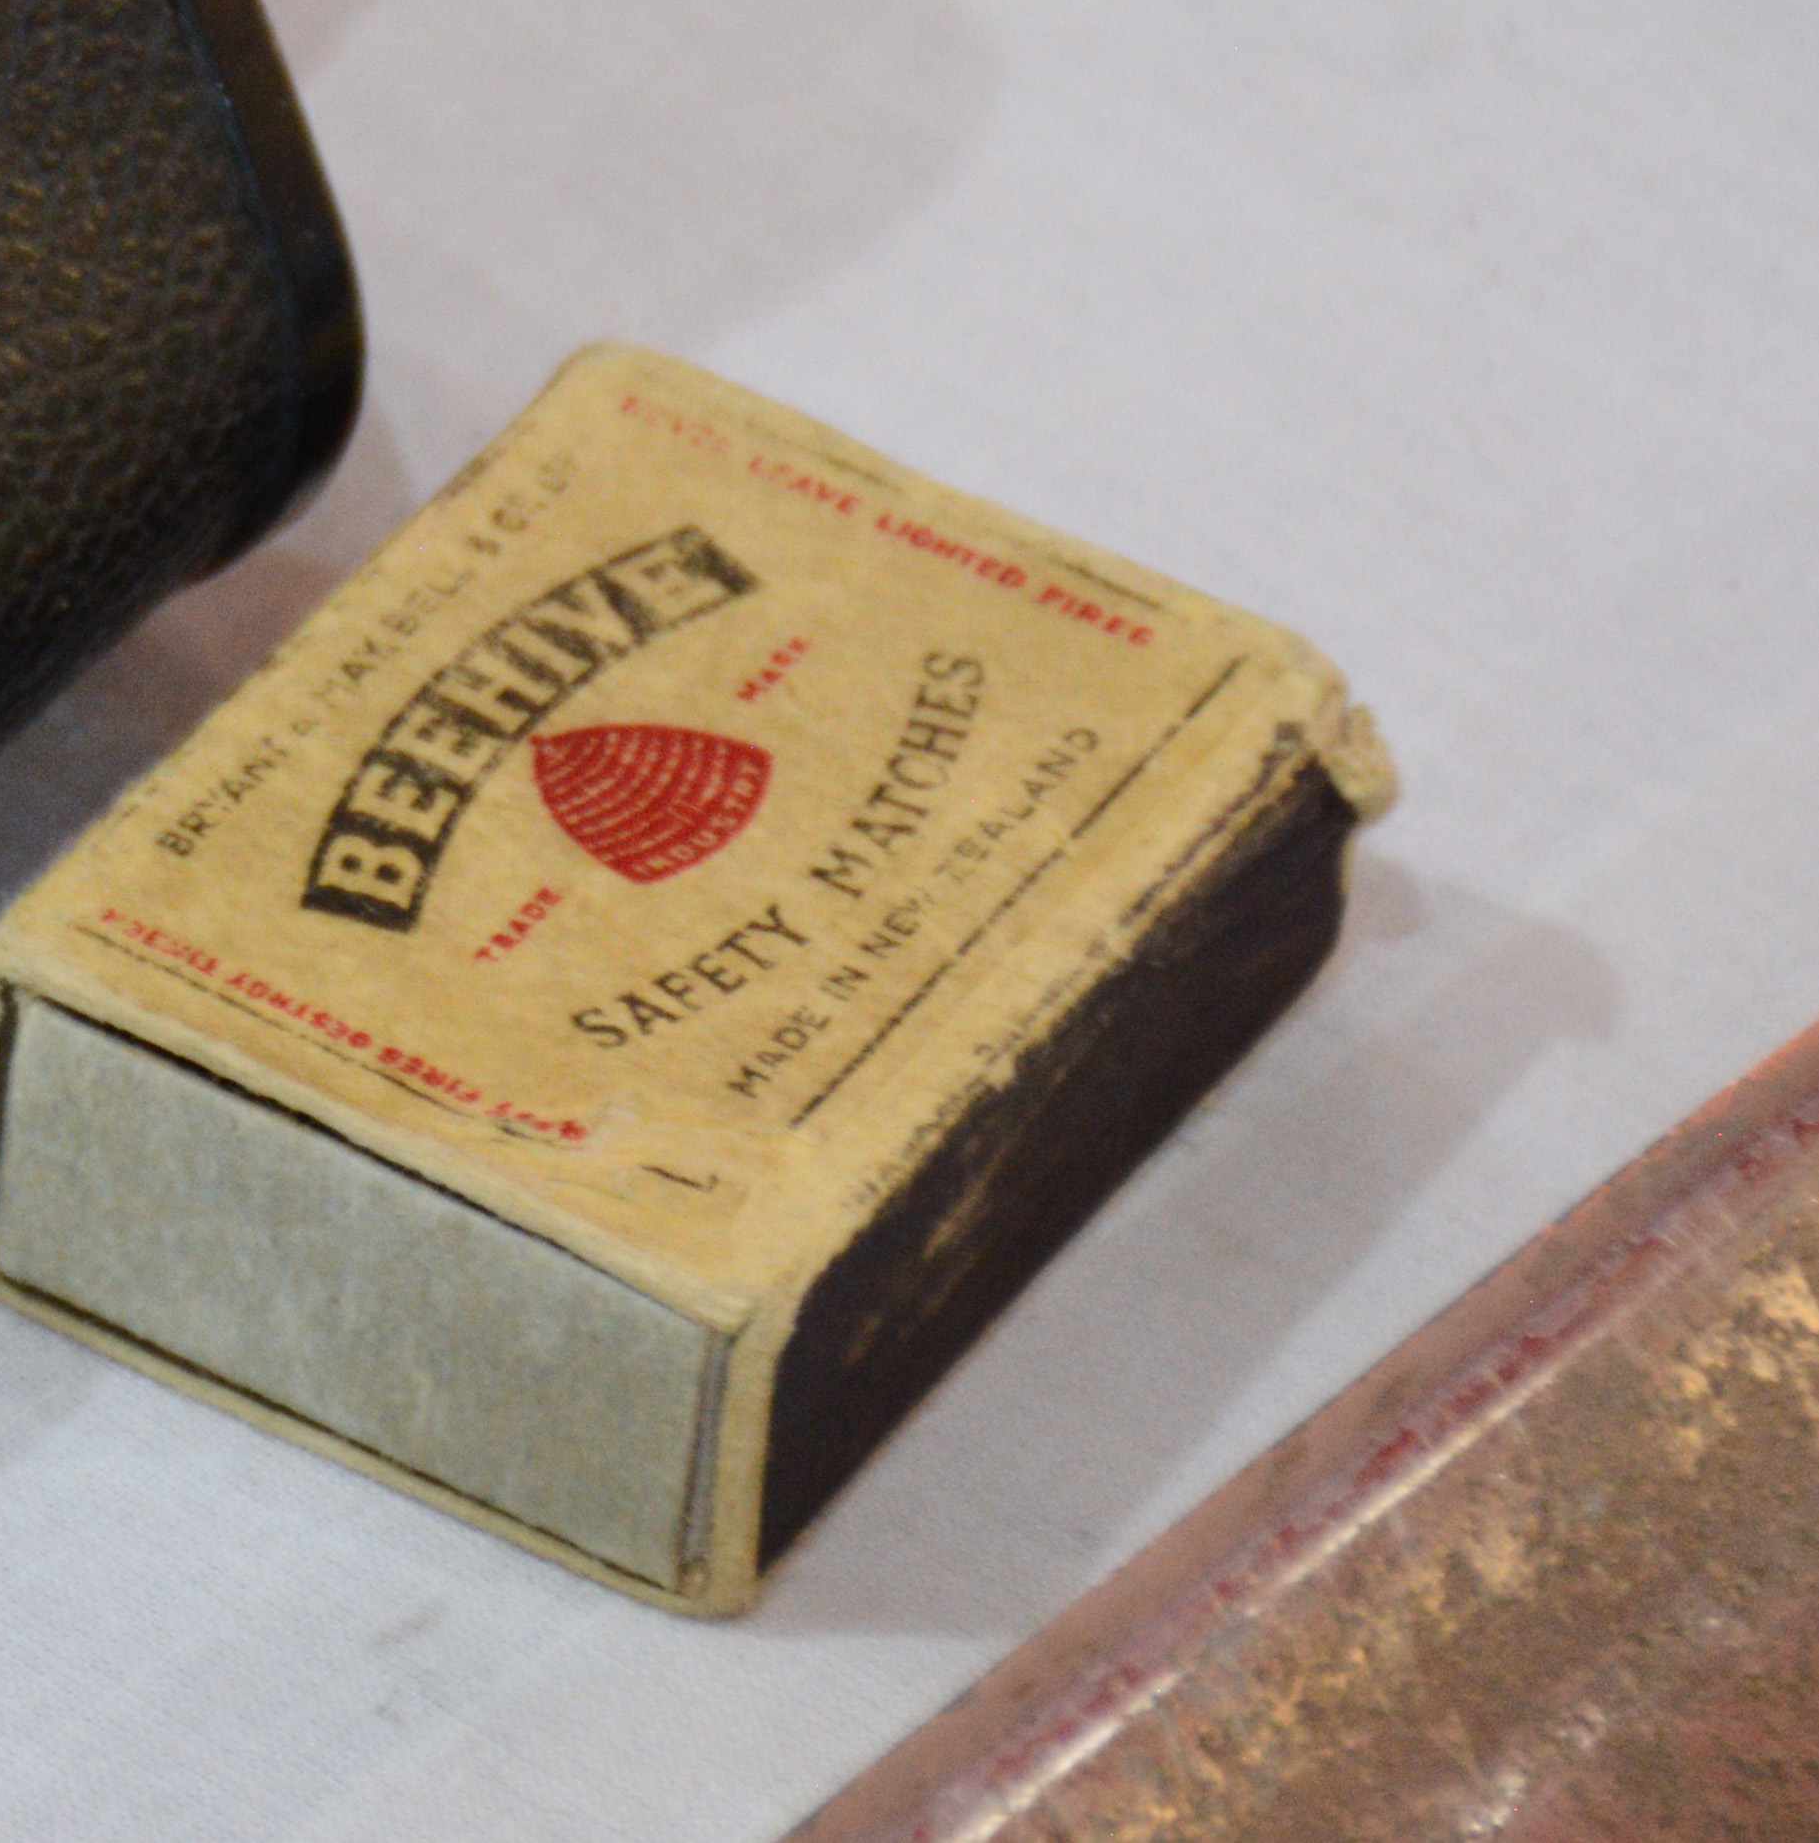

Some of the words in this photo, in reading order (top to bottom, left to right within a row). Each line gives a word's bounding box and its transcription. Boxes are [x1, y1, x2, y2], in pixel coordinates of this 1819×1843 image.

[873, 512, 1029, 592] LIGHTED
[314, 537, 738, 911] BEEHIVE
[473, 886, 563, 961] TRADE
[735, 635, 813, 703] MARK
[570, 903, 811, 1049] SAFETY
[808, 649, 986, 902] MATCHES
[632, 760, 761, 878] INDUSTRY
[223, 971, 374, 1050] DESTROY
[726, 1005, 831, 1100] MADE
[821, 964, 870, 1002] IN
[861, 889, 938, 960] NEW
[935, 727, 1101, 885] ZEALAND
